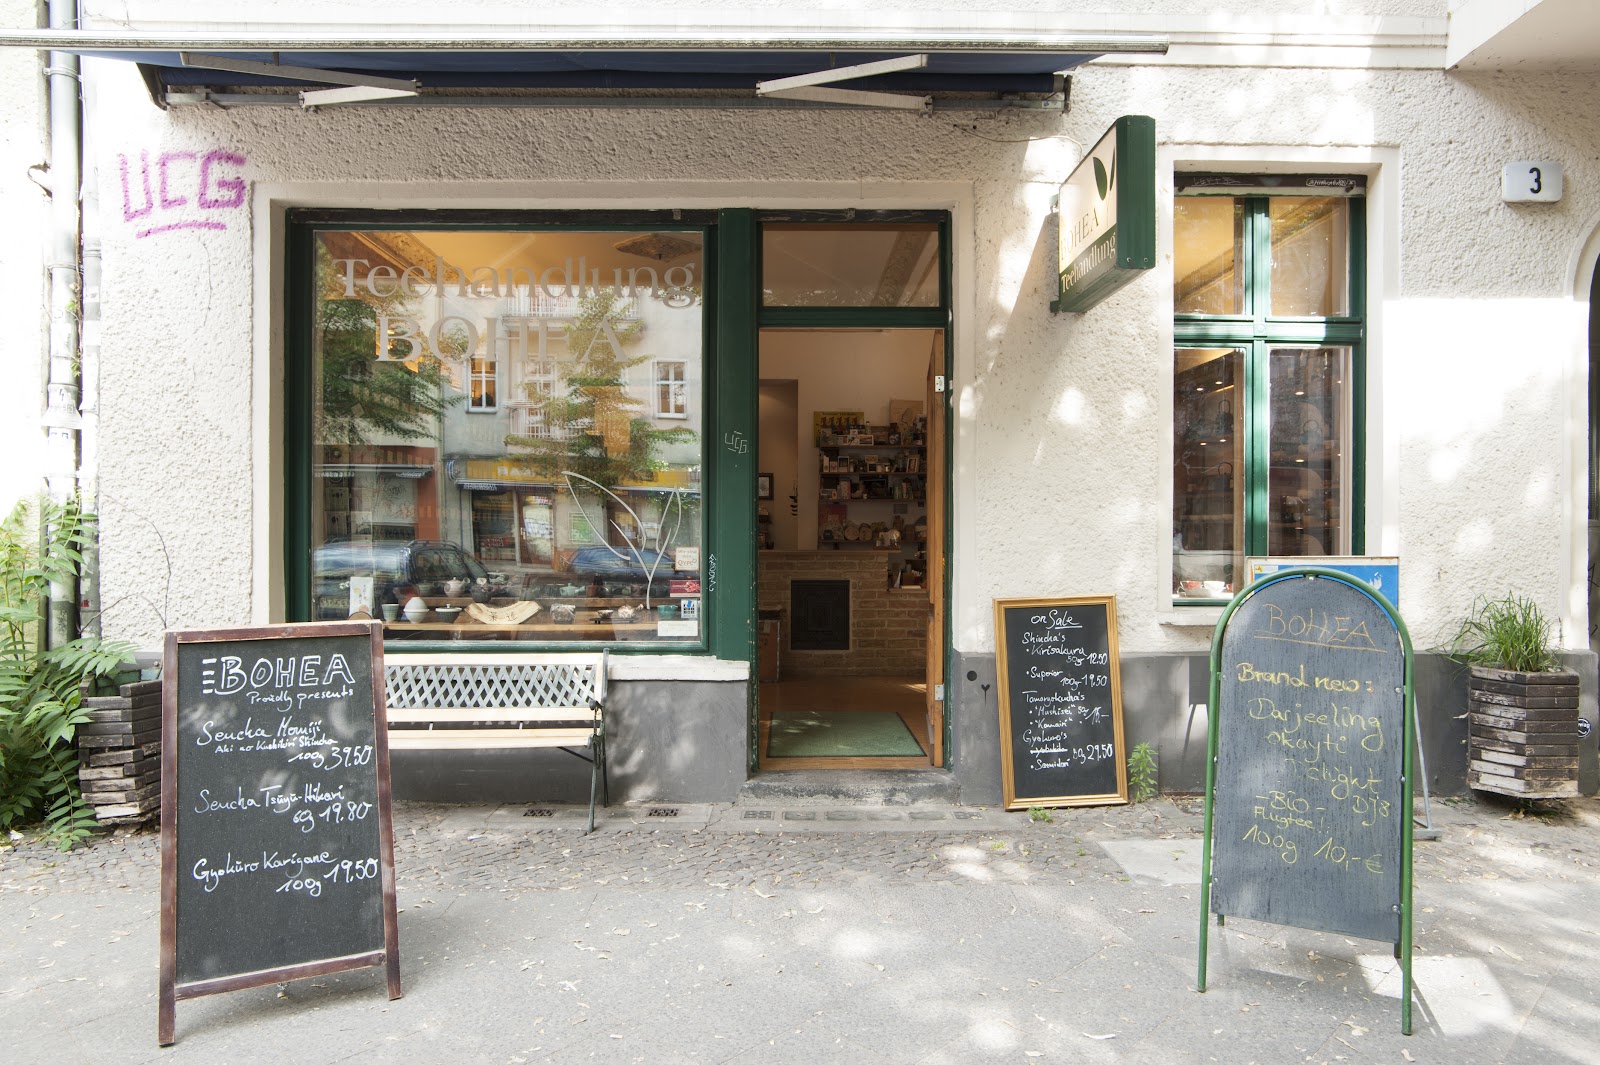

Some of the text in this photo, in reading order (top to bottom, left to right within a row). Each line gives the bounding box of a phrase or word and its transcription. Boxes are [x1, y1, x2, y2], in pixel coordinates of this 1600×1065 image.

[117, 149, 247, 223] UCG
[1528, 166, 1542, 194] 3
[1061, 231, 1117, 294] Teehandlung
[332, 255, 697, 309] Teehandlung
[375, 315, 631, 364] BOHEA
[1046, 609, 1081, 630] Sale
[1256, 603, 1376, 647] BOHEA
[213, 653, 356, 696] BOHEA
[1236, 662, 1310, 688] Brand
[296, 684, 354, 709] presents
[196, 717, 272, 746] Sencha
[1248, 697, 1384, 751] Darjeeling
[194, 786, 261, 813] Sencha
[318, 801, 373, 824] 19.80
[1242, 824, 1298, 864] 100g
[276, 878, 322, 897] 100g
